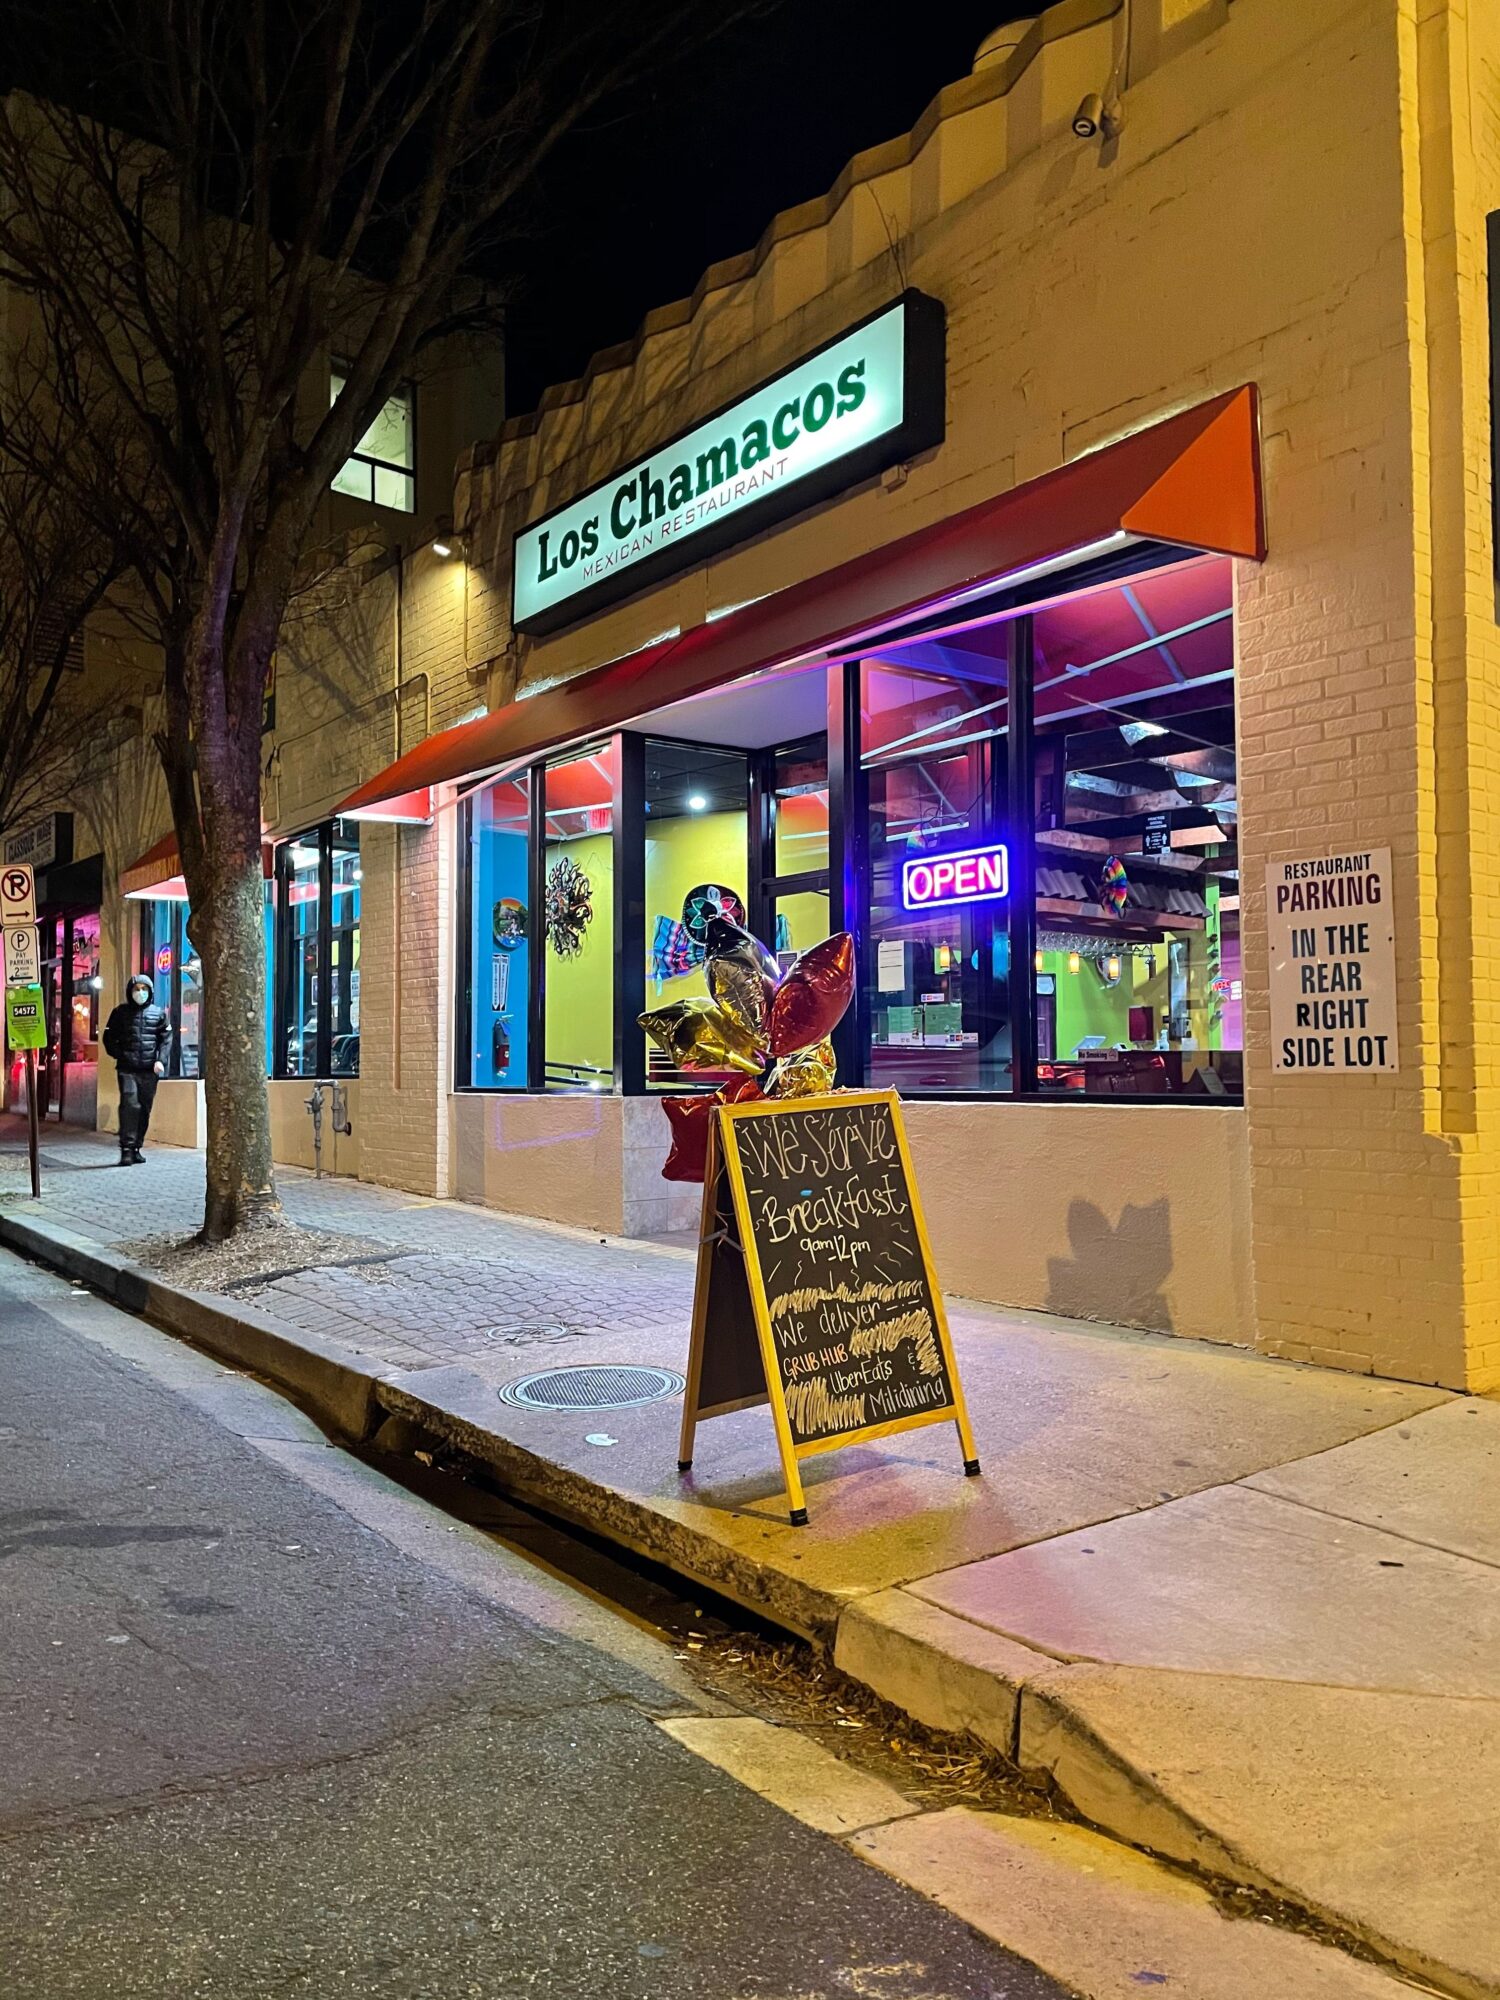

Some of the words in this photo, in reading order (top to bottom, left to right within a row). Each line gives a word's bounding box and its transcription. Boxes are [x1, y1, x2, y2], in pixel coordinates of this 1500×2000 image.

[537, 515, 600, 584] Los
[609, 357, 867, 540] Chamacos
[582, 534, 654, 581] MEXICAN
[660, 457, 790, 536] RESTAURANT
[907, 853, 1001, 902] OPEN
[1284, 853, 1372, 881] RESTAURANT
[1276, 873, 1382, 914] PARKING
[15, 951, 27, 959] PAY
[1291, 927, 1317, 959] IN
[1324, 922, 1371, 956] THE
[9, 958, 34, 966] PARKING
[1300, 961, 1363, 994] REAR
[14, 1006, 36, 1016] 54572
[1295, 998, 1370, 1031] RIGHT
[1282, 1036, 1336, 1068] SIDE
[1344, 1035, 1389, 1067] LOT
[741, 1115, 808, 1180] We
[803, 1114, 897, 1178] Serve
[762, 1173, 909, 1244] Breakfast
[775, 1314, 808, 1349] We
[818, 1301, 881, 1336] deliver
